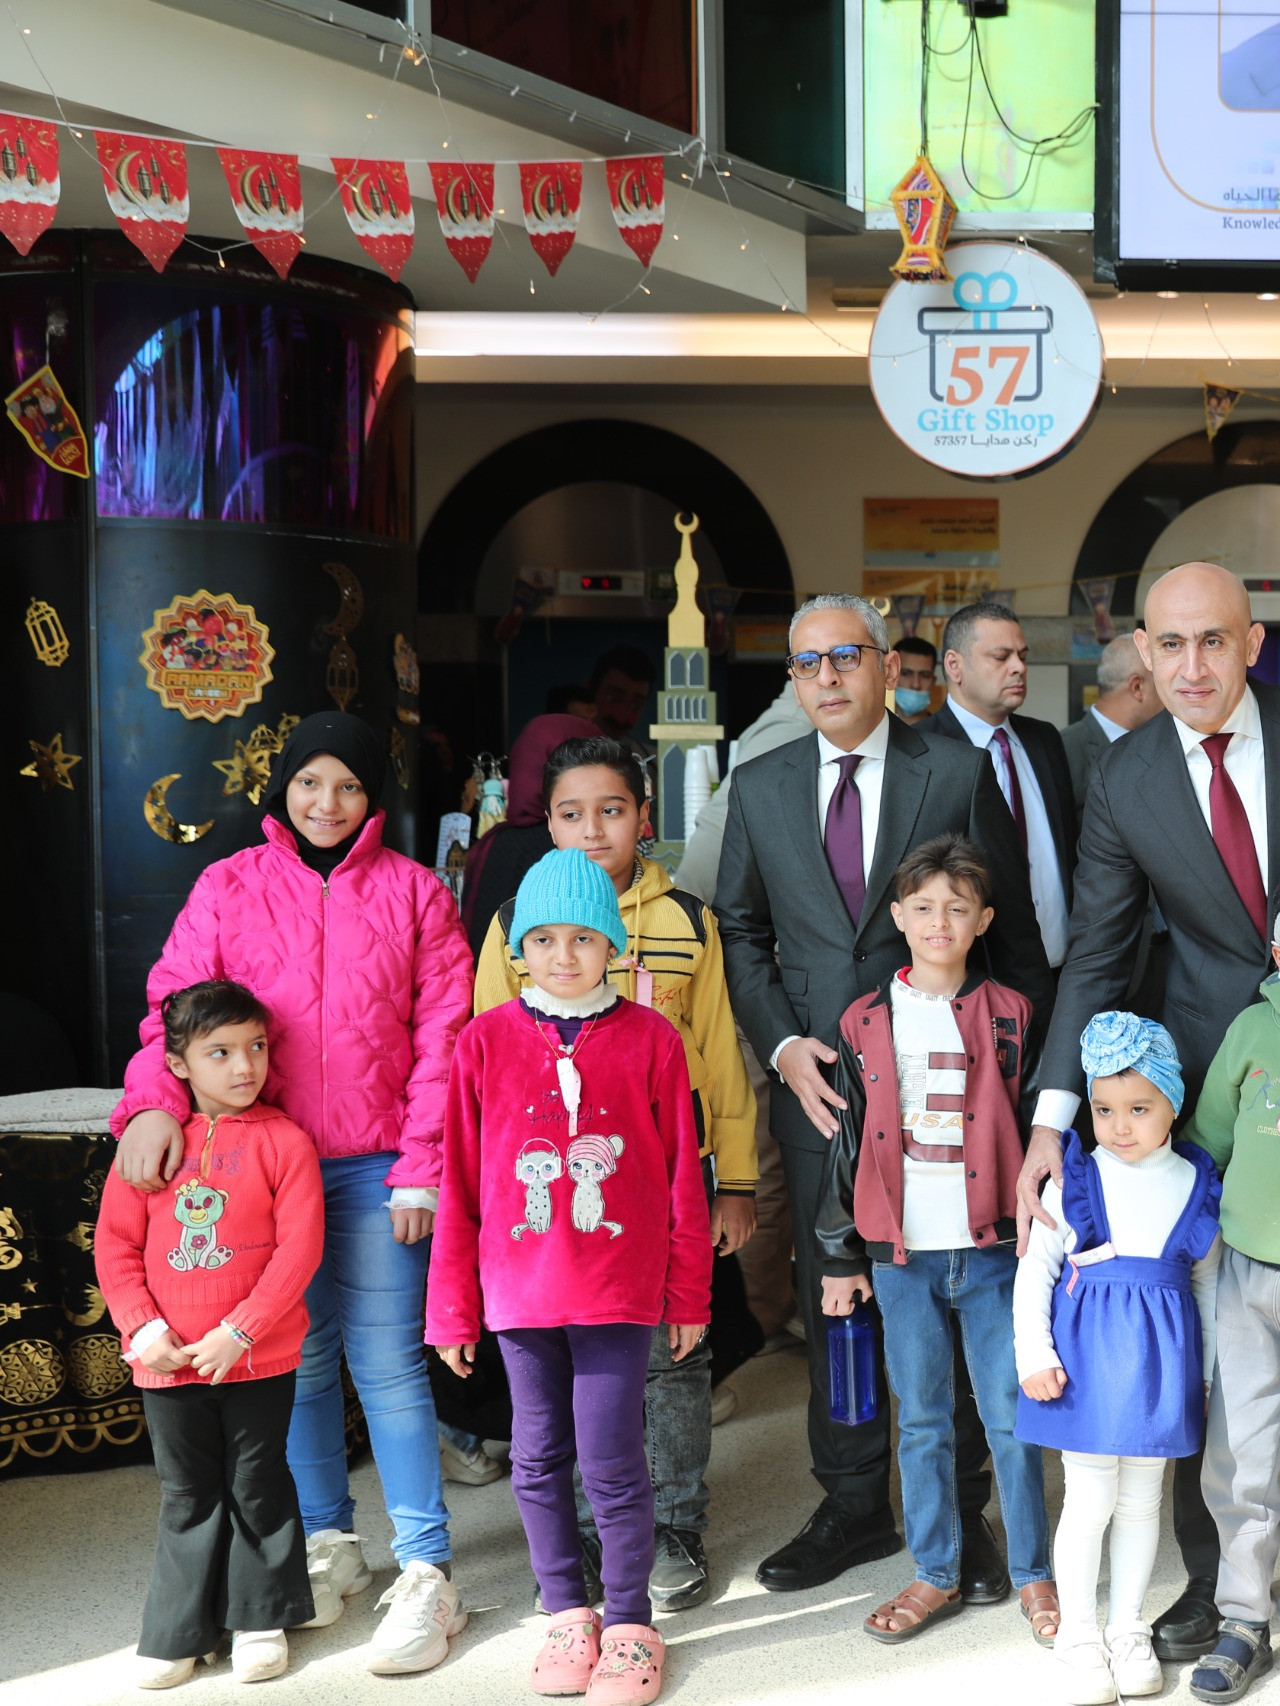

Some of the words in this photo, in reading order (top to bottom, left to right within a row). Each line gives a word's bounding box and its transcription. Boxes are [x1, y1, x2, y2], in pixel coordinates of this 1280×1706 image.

[946, 346, 1031, 406] 57
[917, 408, 976, 432] Gift
[985, 408, 1054, 436] Shop
[934, 435, 967, 446] 57357
[1013, 434, 1038, 447] ركن
[166, 673, 254, 688] RAMADAN
[901, 1053, 927, 1110] EIGHTY
[901, 1112, 963, 1129] USA
